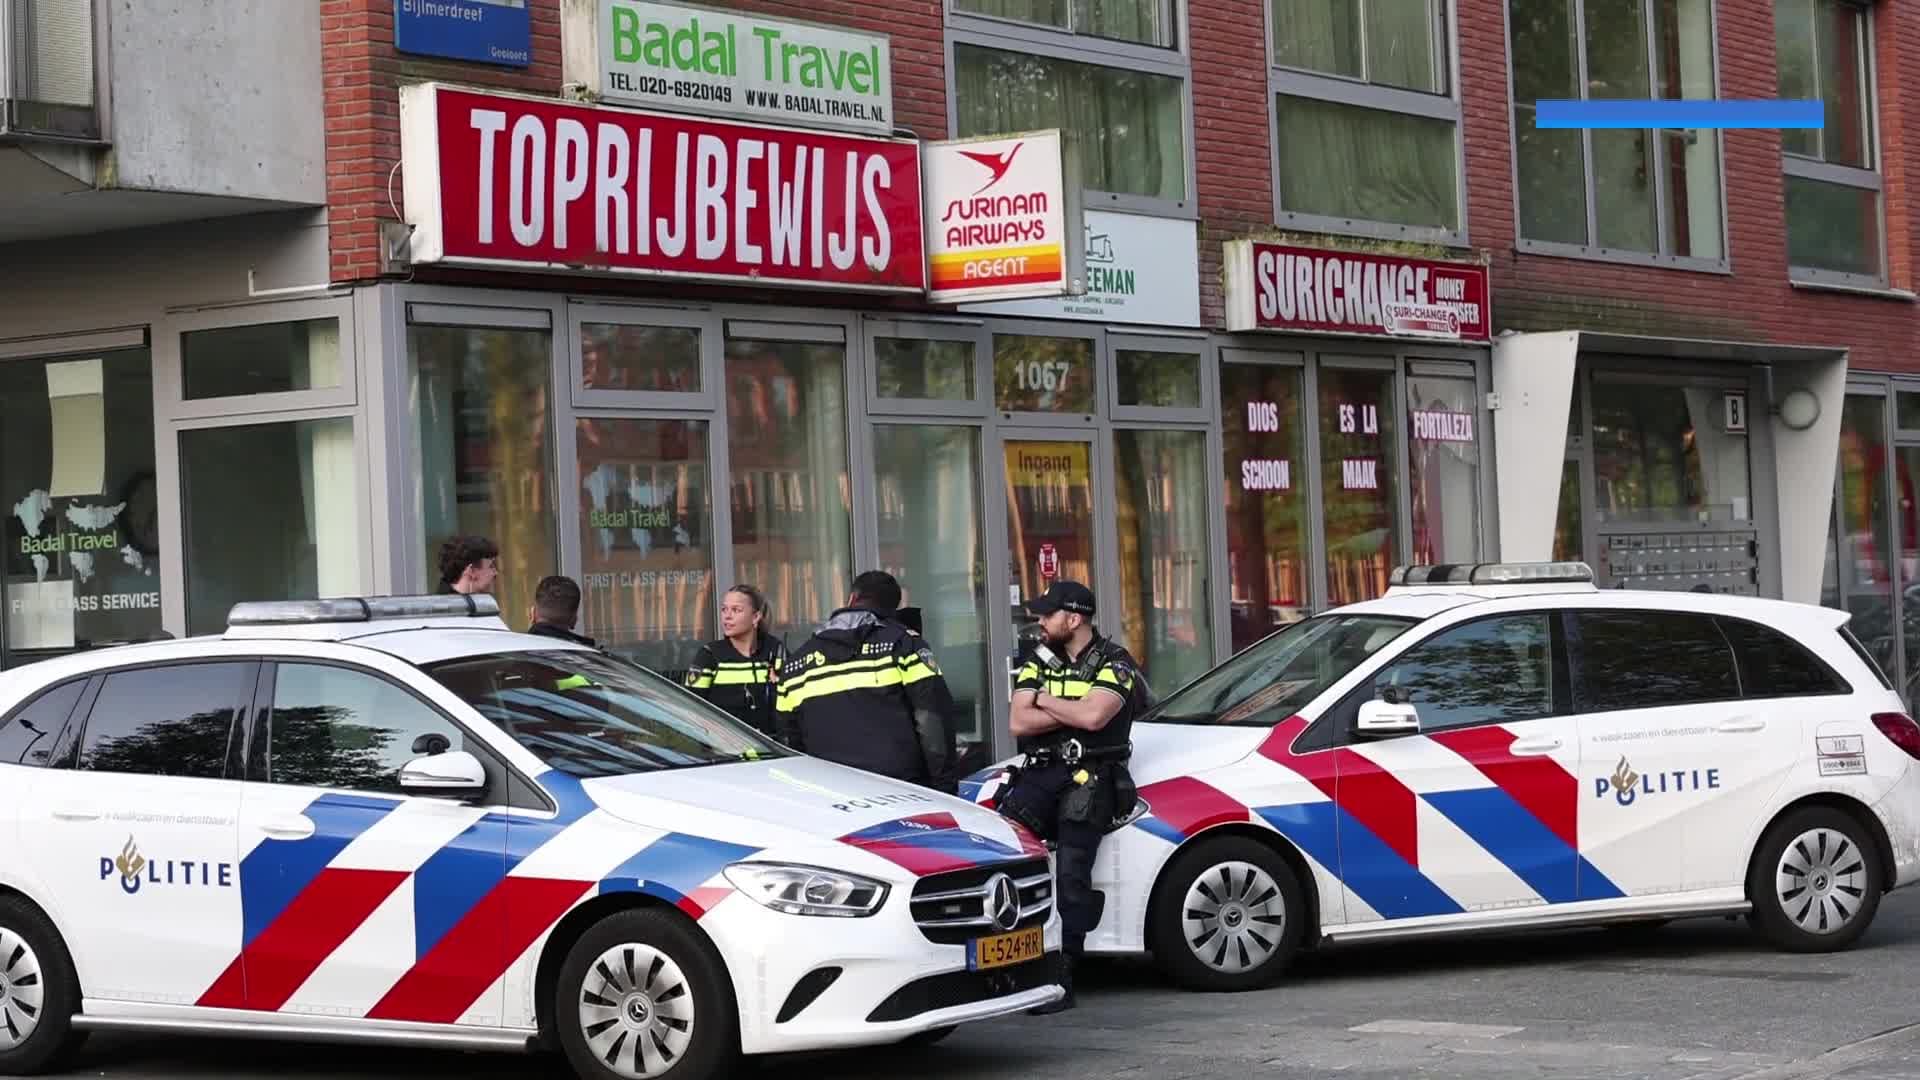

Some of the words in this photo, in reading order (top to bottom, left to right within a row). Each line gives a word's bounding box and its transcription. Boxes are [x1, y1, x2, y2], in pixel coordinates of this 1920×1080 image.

[611, 6, 736, 77] Badal
[753, 26, 882, 97] Travel
[470, 108, 892, 272] TOPRIJBEWIJS
[942, 192, 1047, 222] SURINAM
[946, 219, 1045, 248] AIRWAYS
[963, 256, 1029, 280] AGENT
[1085, 266, 1135, 295] EEMAN
[1257, 250, 1429, 326] SURICHANGE
[1436, 276, 1465, 301] MONEY
[1393, 305, 1448, 321] SURI-CHANGE
[1014, 360, 1072, 392] 1067
[1247, 402, 1279, 432] DIOS
[1339, 404, 1355, 433] ES
[1363, 405, 1378, 434] LA
[1413, 411, 1474, 441] FORTALEZA
[1018, 449, 1072, 478] Ingang
[1242, 459, 1290, 490] SCHOON
[1343, 460, 1378, 489] MAAK
[590, 510, 628, 528] Badal
[631, 508, 671, 528] Travel
[21, 534, 65, 554] Badal
[68, 530, 117, 551] Travel
[72, 595, 99, 612] ASS
[102, 592, 160, 610] SERVICE
[1595, 767, 1721, 806] POLITIE
[100, 855, 232, 894] POLITIE
[983, 932, 1039, 963] L-524-RR
